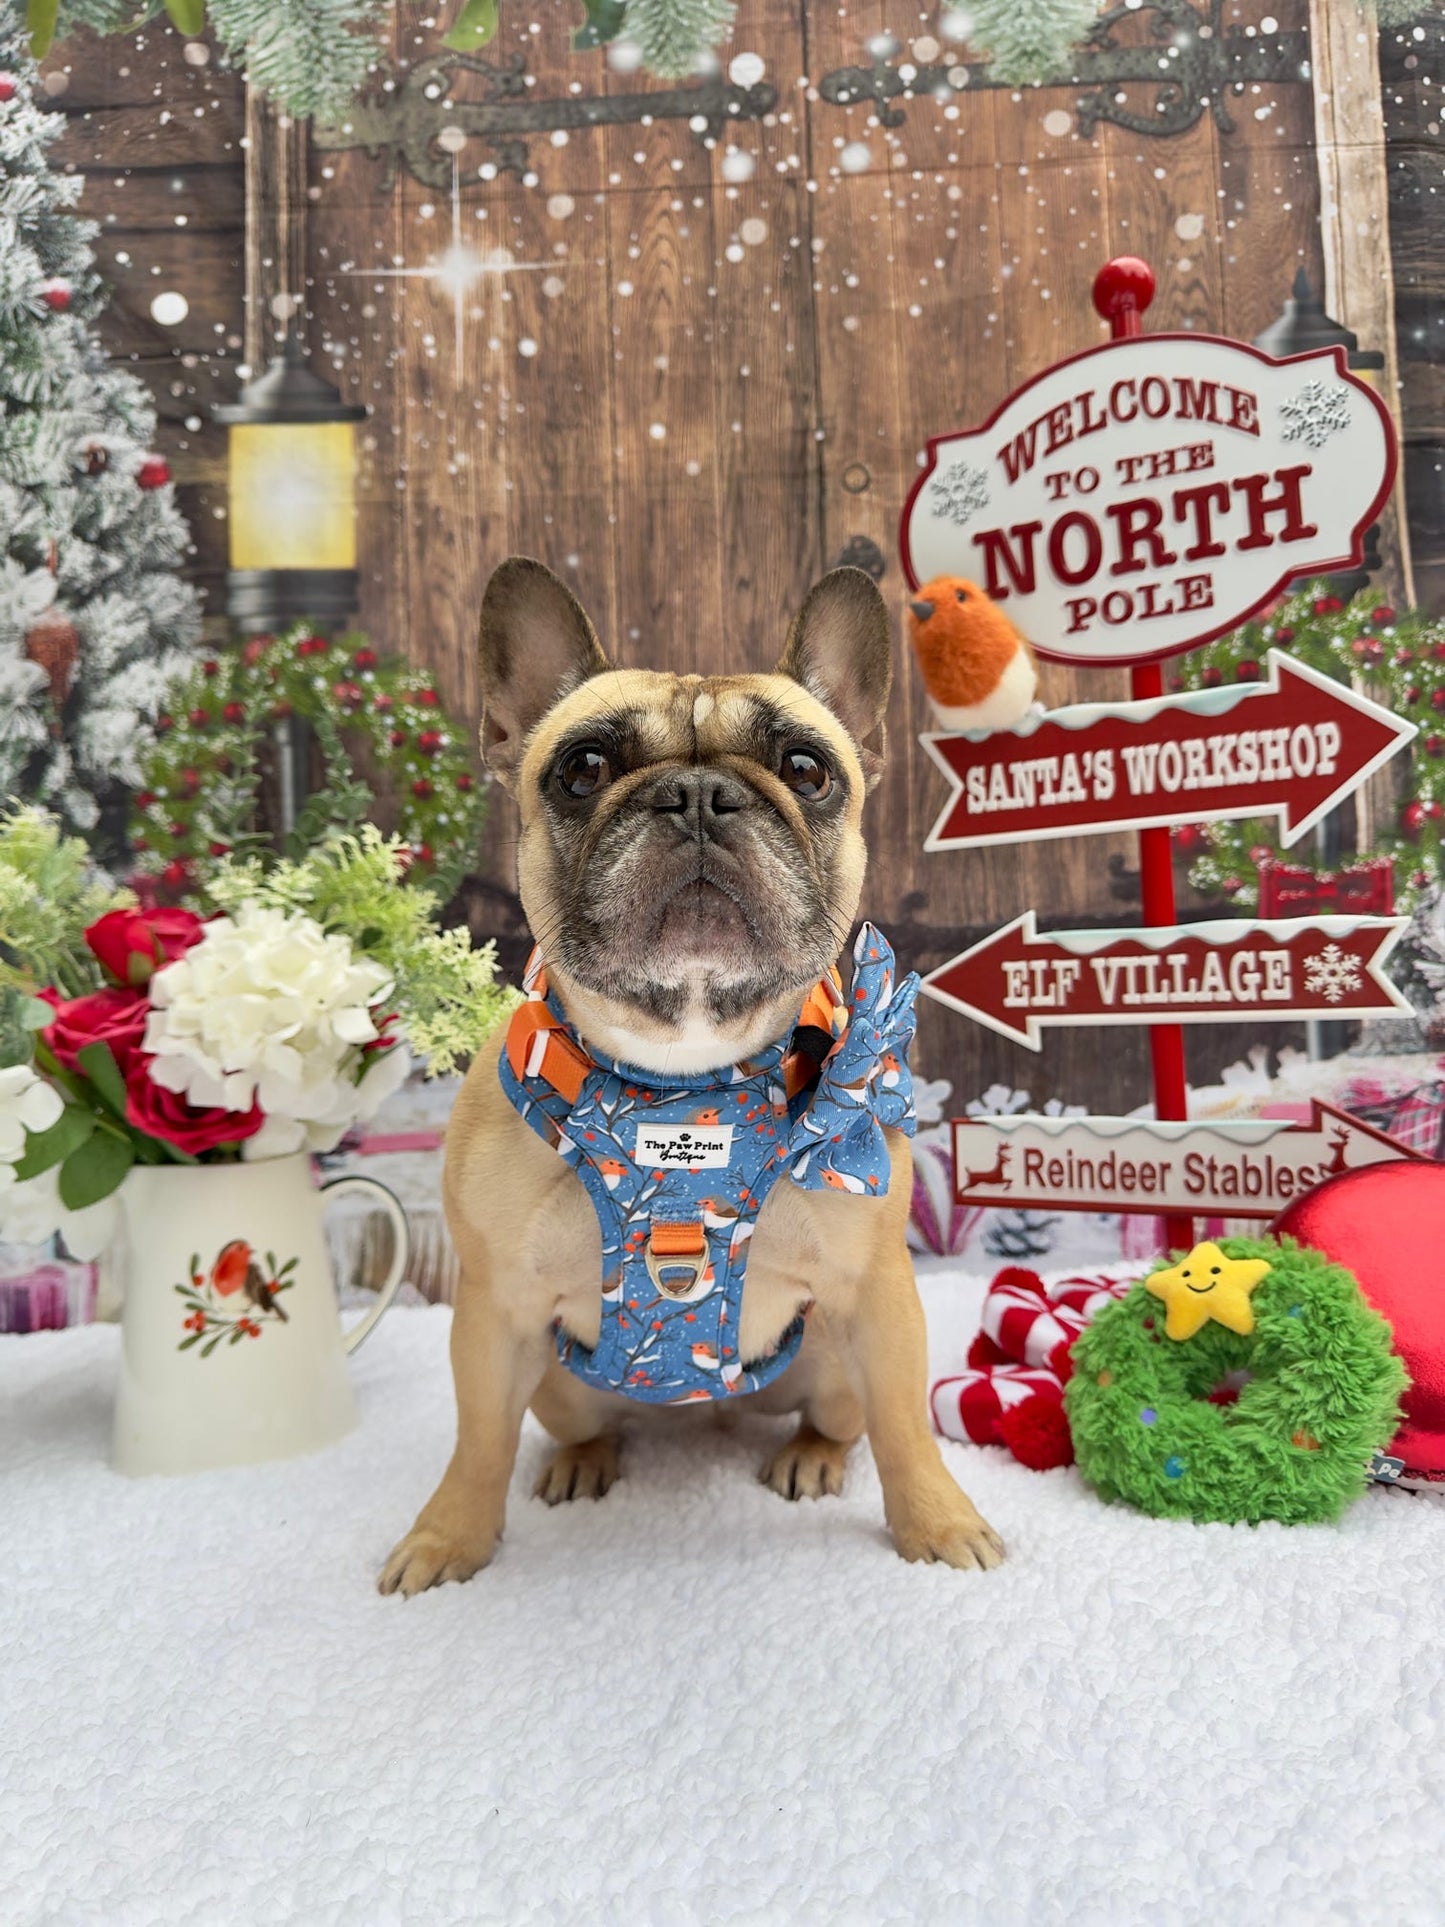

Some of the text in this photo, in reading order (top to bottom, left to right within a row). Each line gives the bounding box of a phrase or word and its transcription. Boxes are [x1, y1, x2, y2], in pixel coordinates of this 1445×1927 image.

[997, 376, 1261, 485] WELCOME
[1045, 440, 1215, 500] TO THE
[973, 463, 1318, 600] NORTH
[1065, 572, 1215, 634] POLE
[1121, 722, 1342, 795] WORKSHOP
[1002, 950, 1292, 1007] ELF VILLAGE
[644, 1140, 724, 1150] The Paw Print
[660, 1149, 706, 1164] Boutique
[1023, 1148, 1315, 1199] Reindeer Stables
